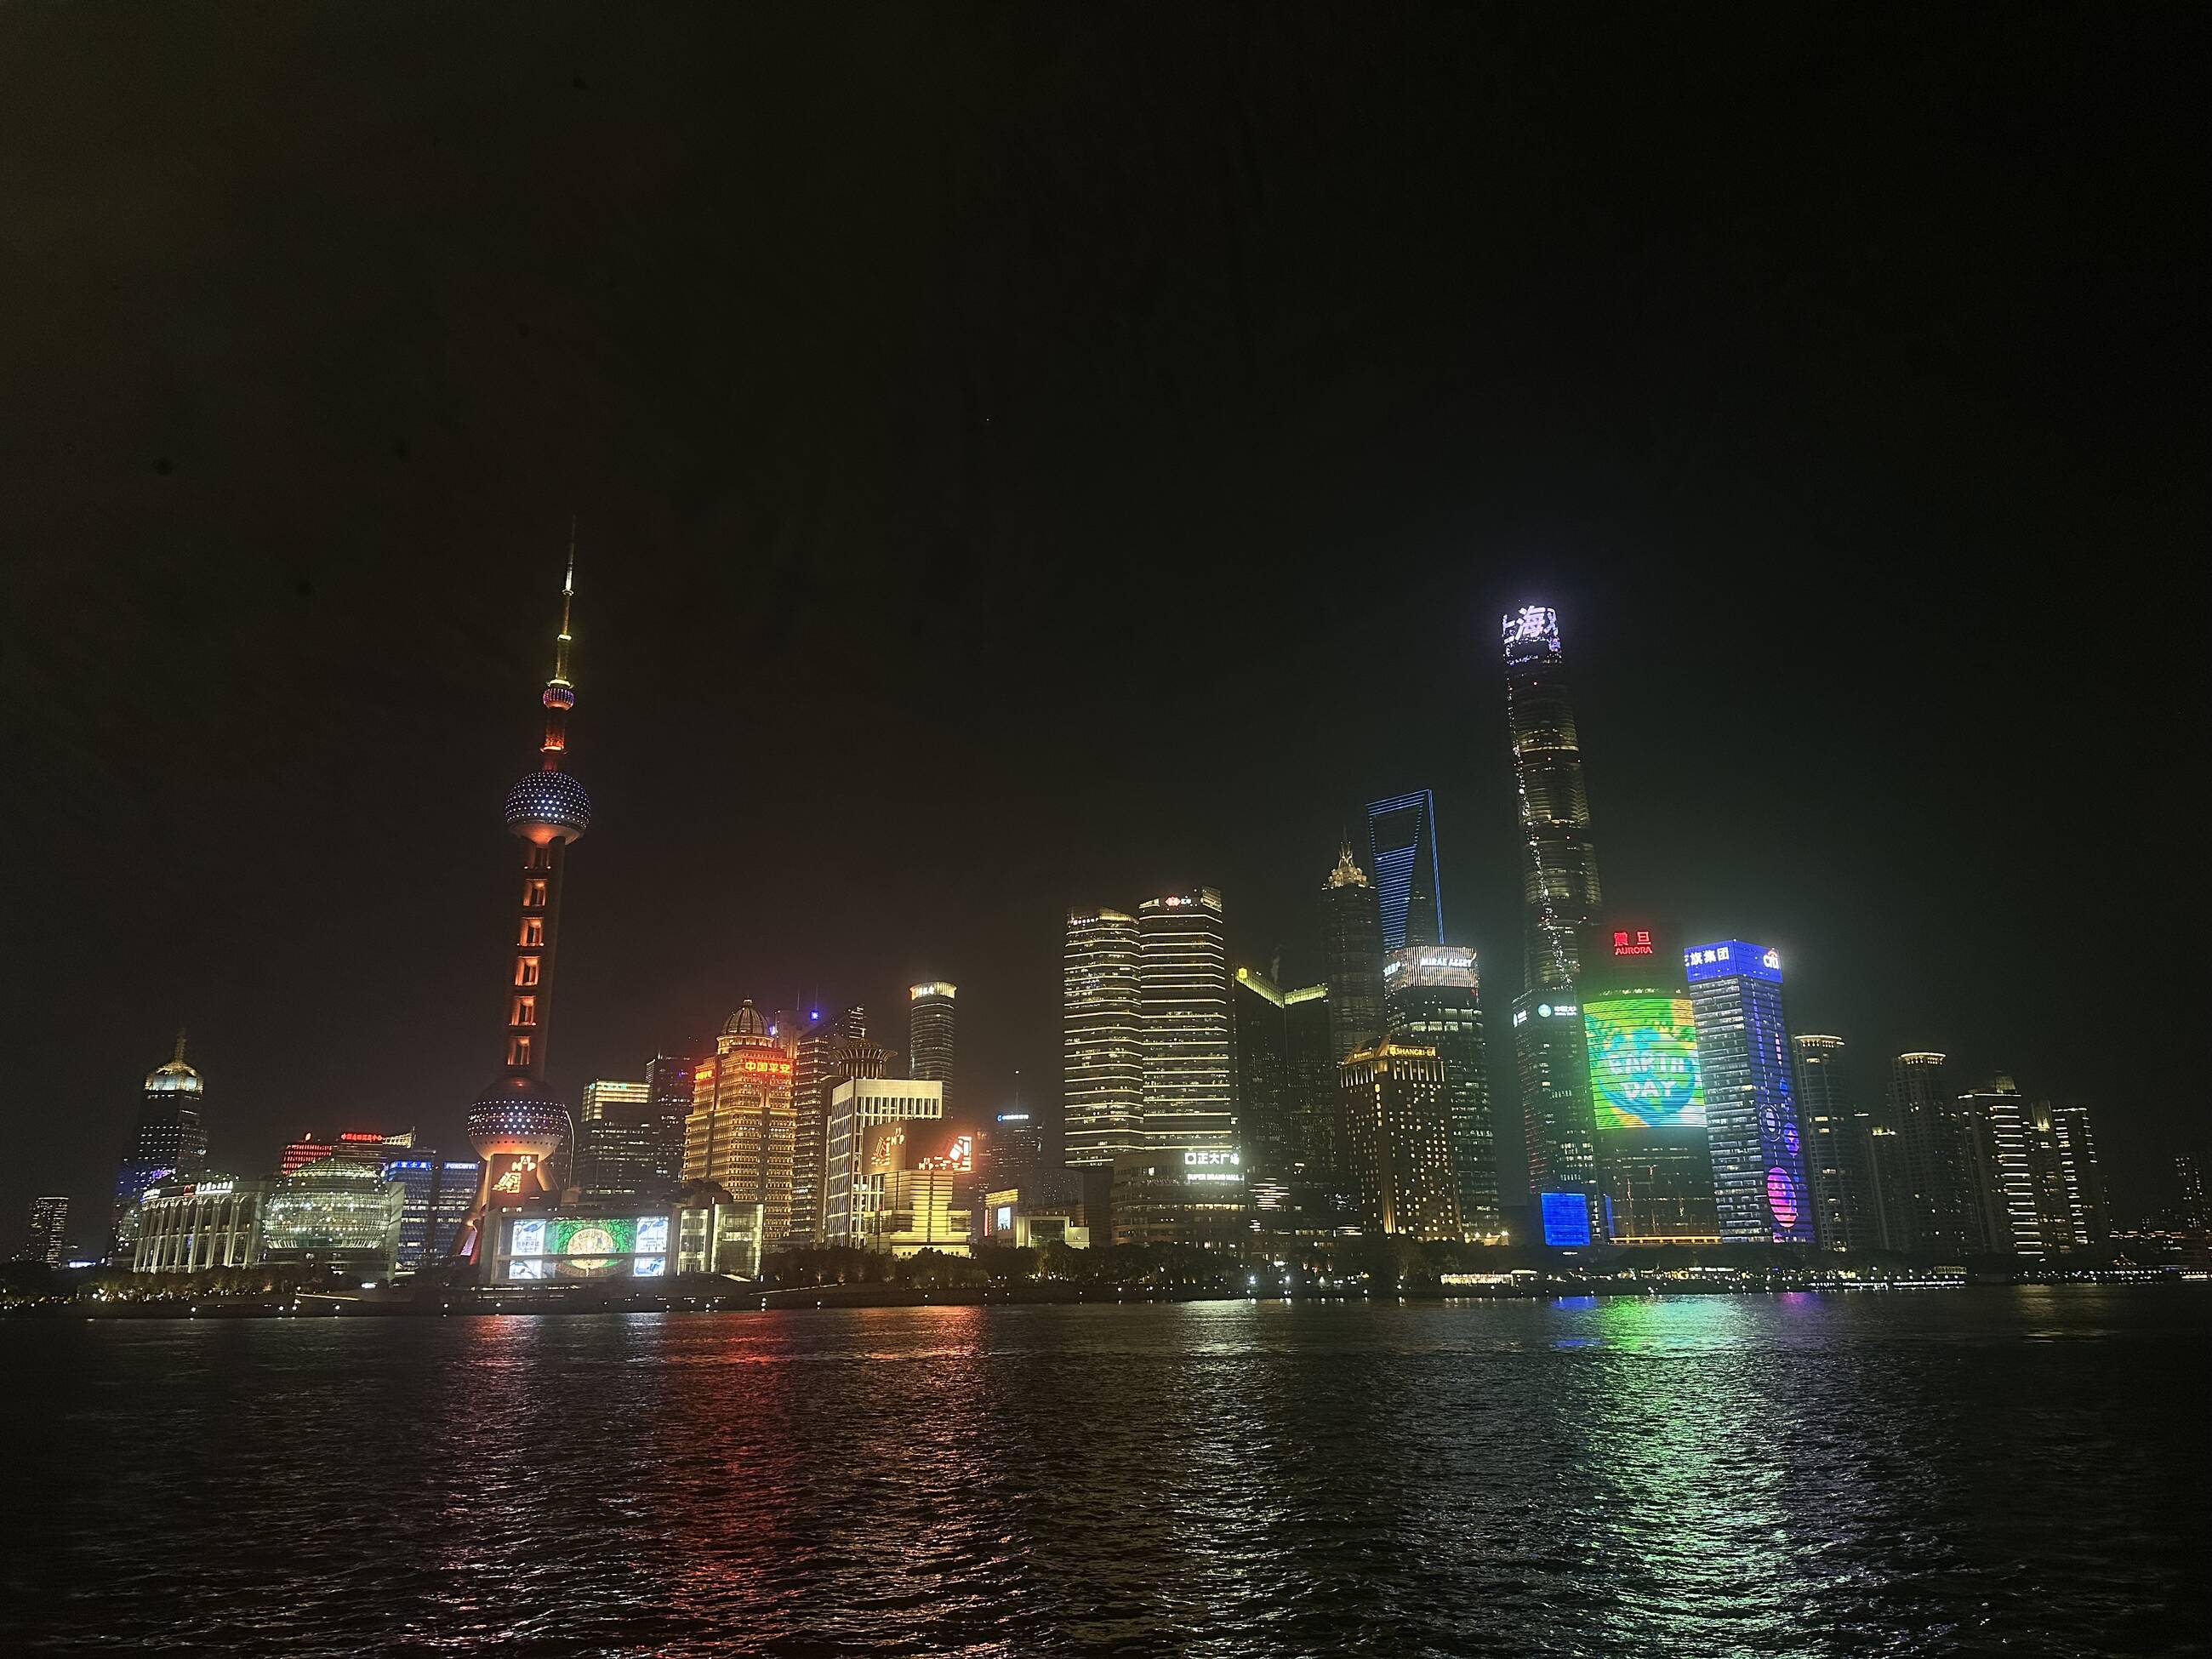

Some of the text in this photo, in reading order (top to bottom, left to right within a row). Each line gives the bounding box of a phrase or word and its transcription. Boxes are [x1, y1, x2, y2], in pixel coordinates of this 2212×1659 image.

[1614, 931, 1651, 946] 震旦
[1615, 946, 1653, 955] AURORA
[1421, 957, 1447, 966] MIRAE
[1396, 1046, 1436, 1057] SHANGRI-LA
[745, 1061, 790, 1074] 中国平安
[1607, 1052, 1685, 1075] EARTH
[1619, 1077, 1677, 1098] DAY
[1197, 1153, 1240, 1166] 正大广场
